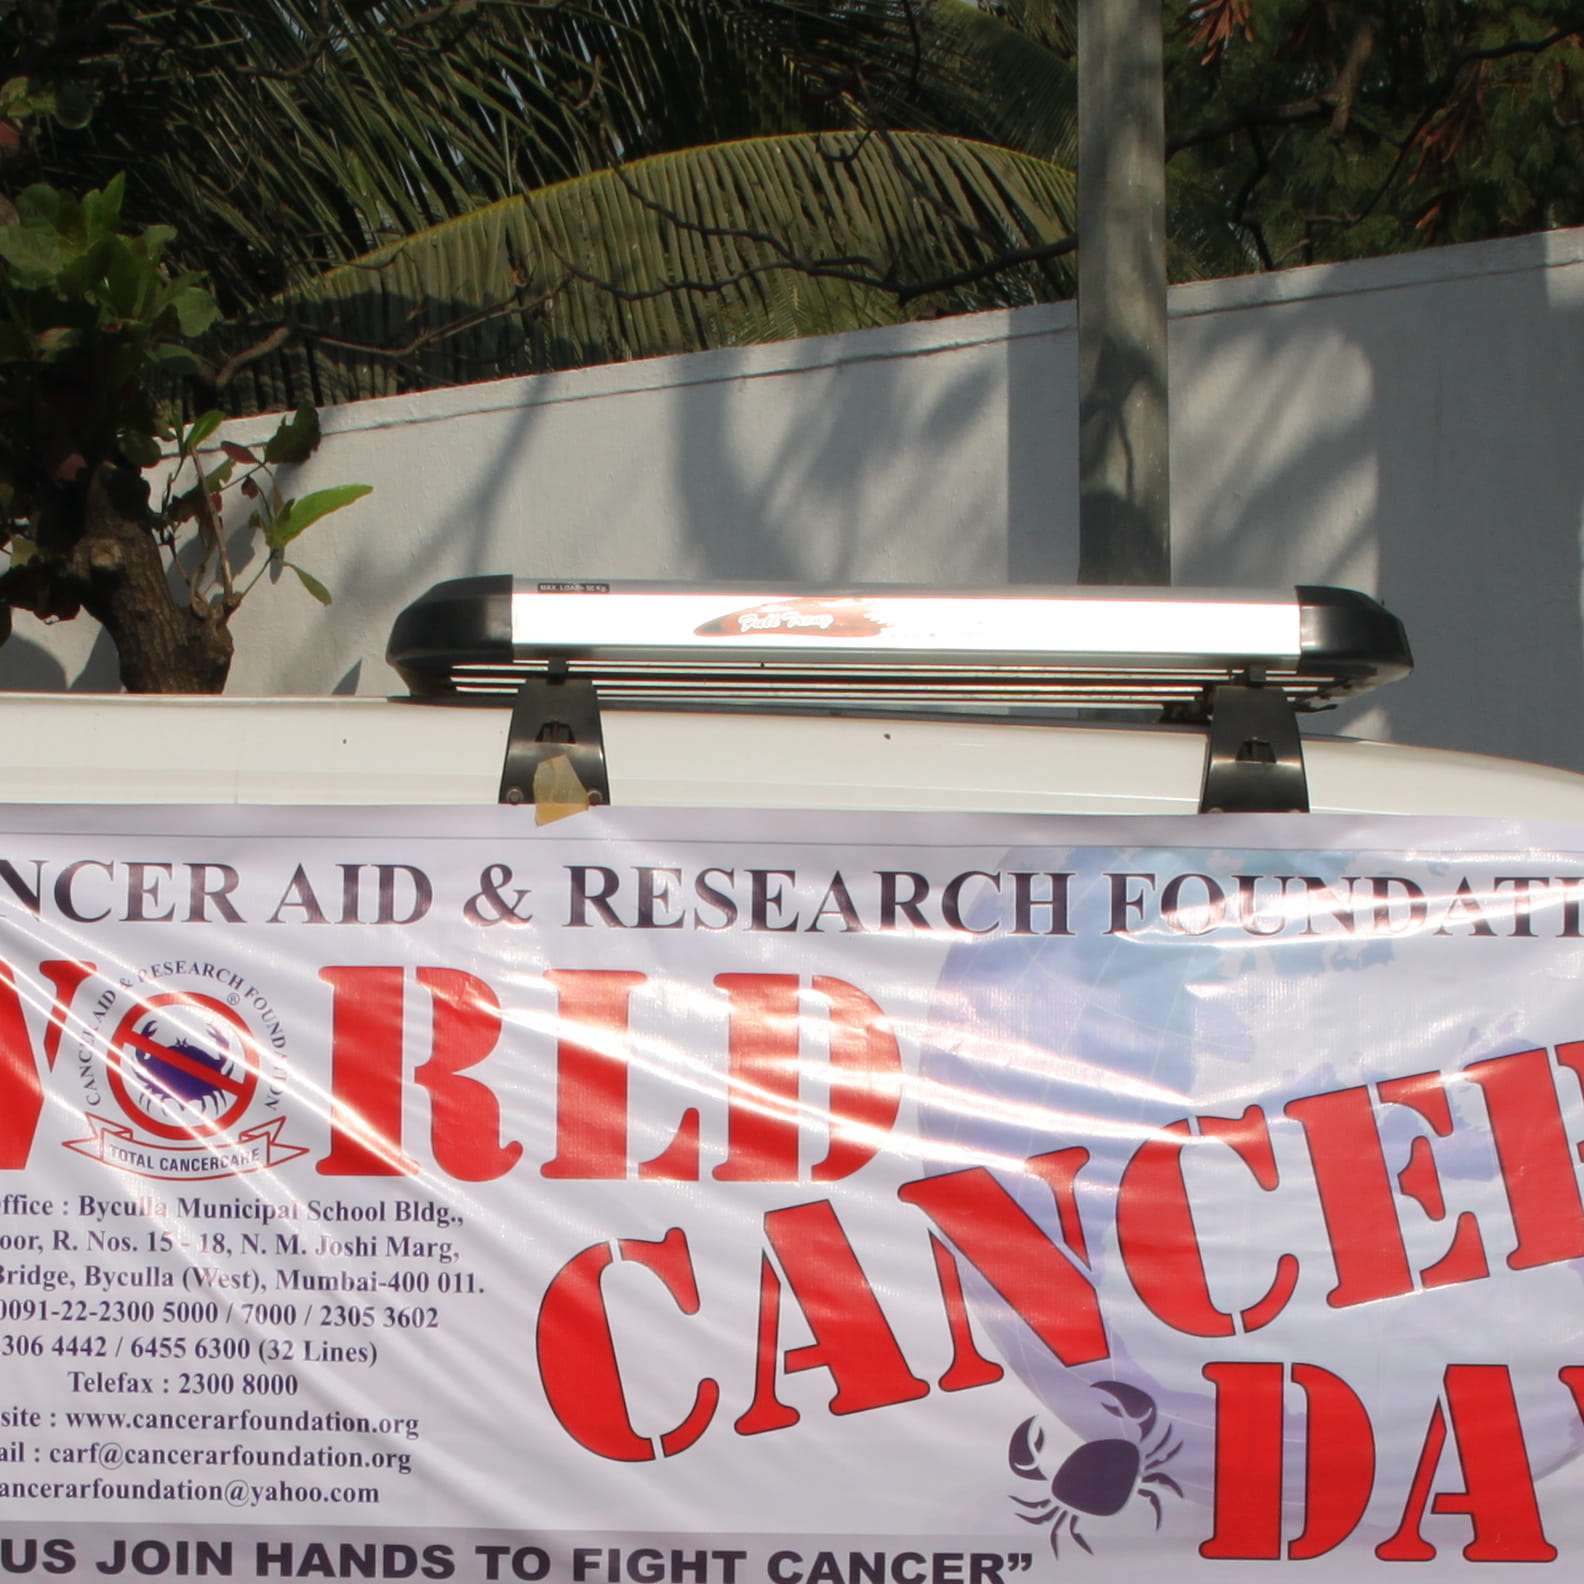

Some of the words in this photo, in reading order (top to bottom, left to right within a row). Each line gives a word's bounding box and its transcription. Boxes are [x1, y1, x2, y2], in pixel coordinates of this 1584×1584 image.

[267, 864, 434, 926] AID
[464, 864, 534, 928] &
[562, 863, 1076, 938] RESEARCH
[109, 1143, 155, 1170] TOTAL
[159, 1148, 261, 1173] CANCERCARE
[86, 1266, 175, 1293] Byculla
[183, 1267, 268, 1293] (West),
[277, 1269, 431, 1294] Mumbai-400
[438, 1273, 486, 1295] 011.
[67, 1409, 420, 1440] www.cancerarfoundation.org
[50, 1443, 413, 1475] carf@cancerarfoundation.org
[0, 1538, 77, 1575] US
[95, 1539, 234, 1578] JOIN
[254, 1541, 456, 1581] HANDS
[474, 1544, 552, 1582] TO
